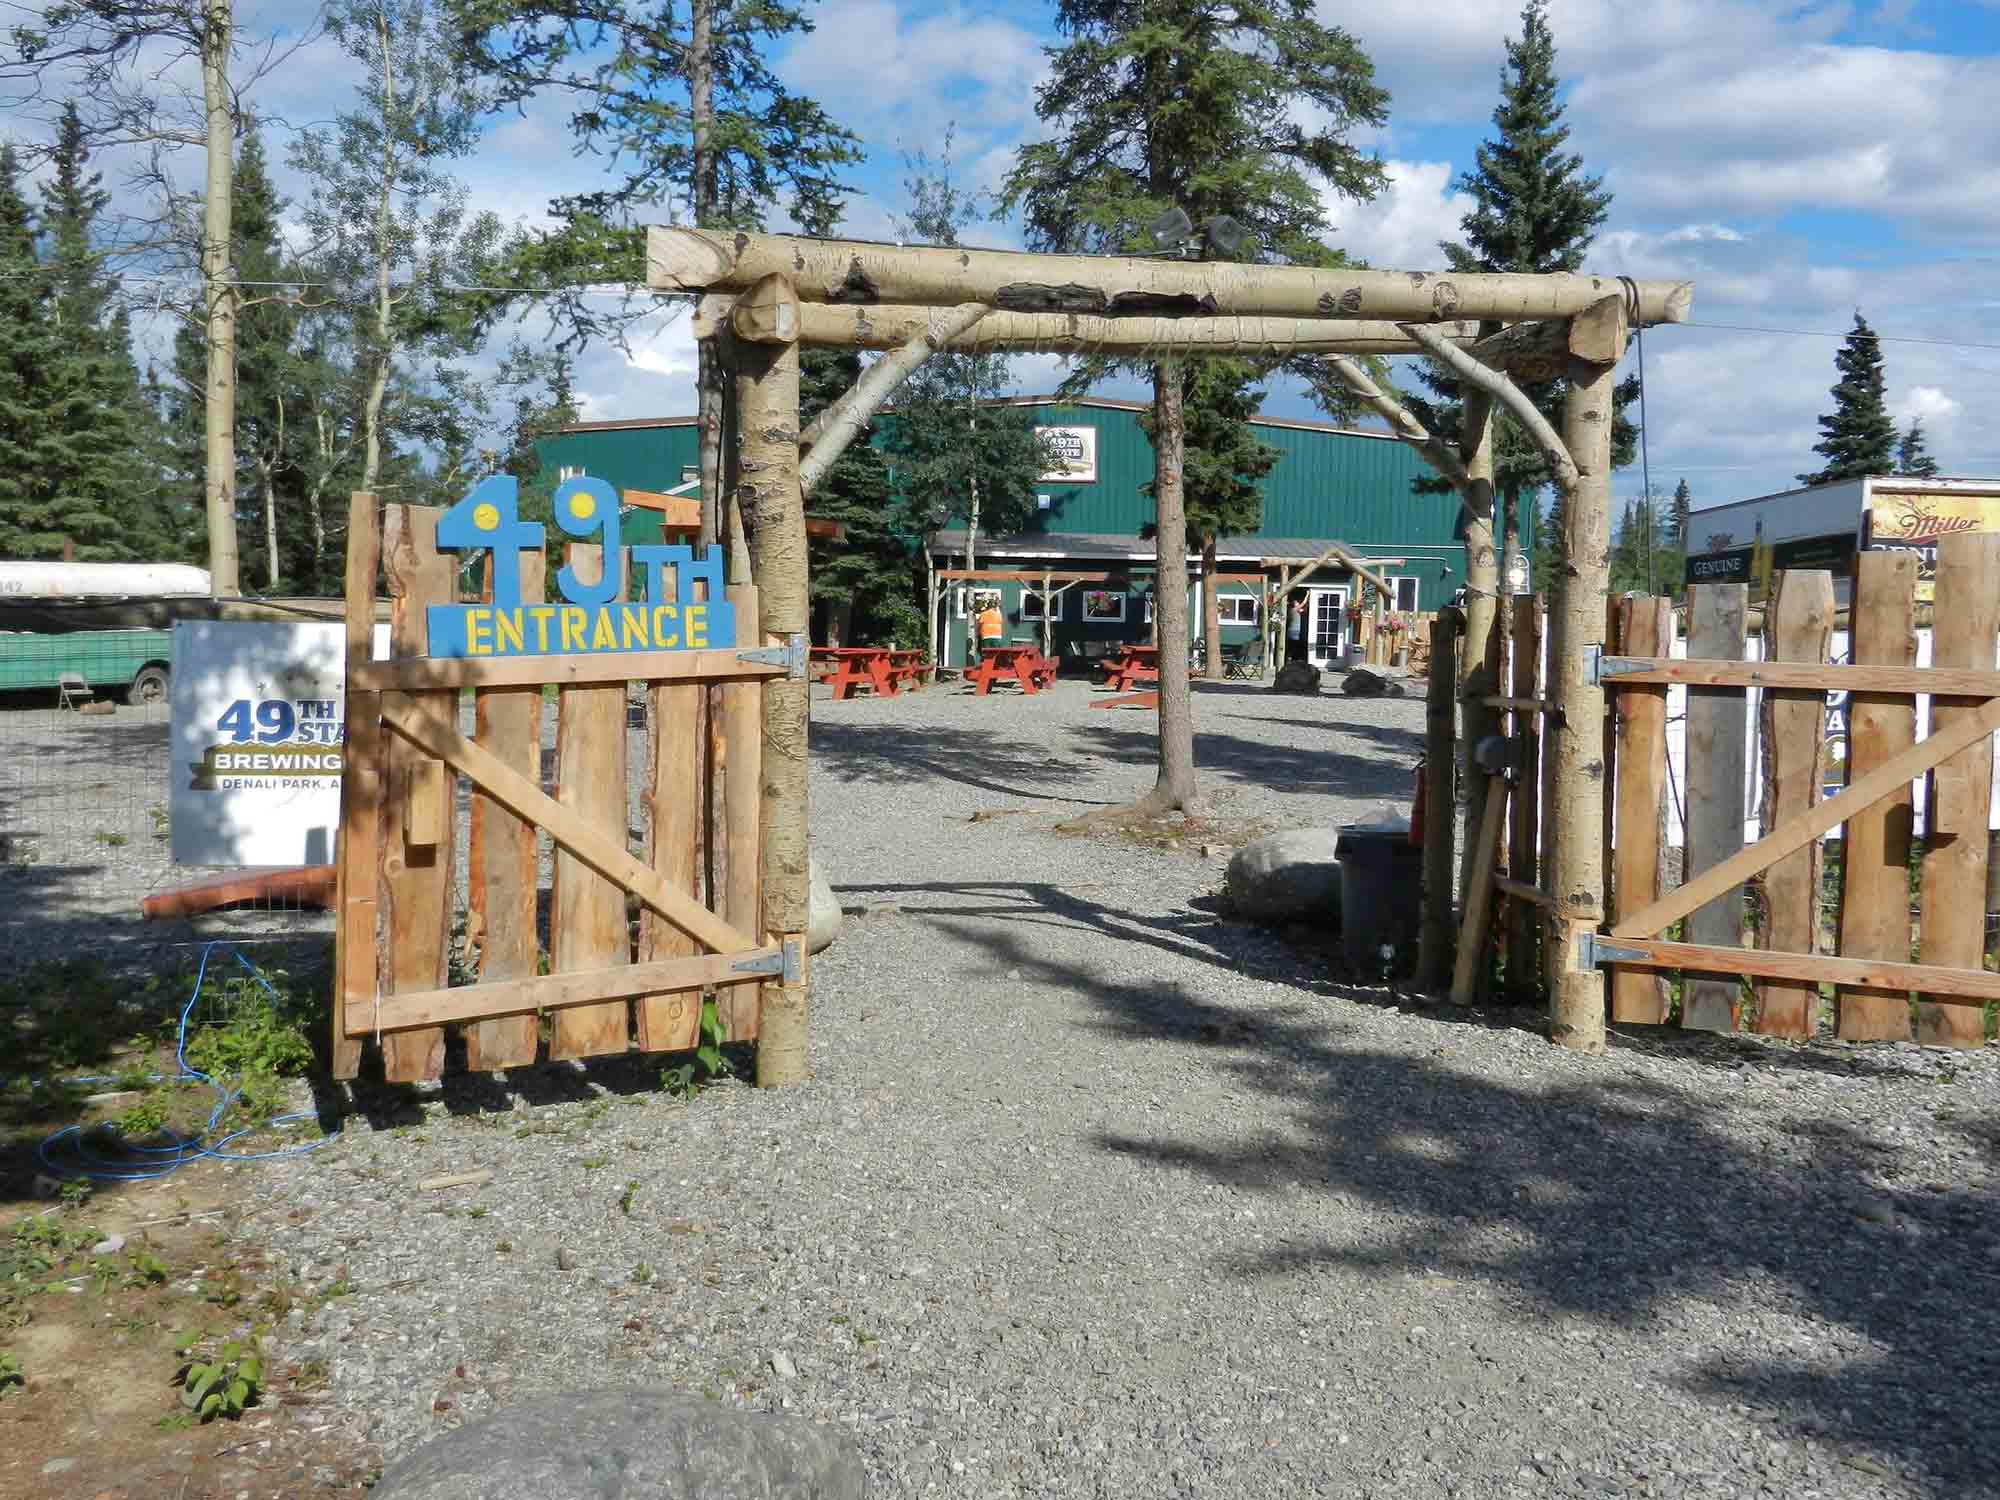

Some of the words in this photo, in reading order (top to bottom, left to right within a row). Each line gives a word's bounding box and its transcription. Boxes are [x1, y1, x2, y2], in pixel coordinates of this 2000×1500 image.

[1900, 514, 1981, 537] Miller
[436, 474, 725, 604] 49TH
[1694, 558, 1742, 576] GENUINE
[465, 605, 708, 656] ENTRANCE
[215, 754, 342, 769] BREWING
[223, 779, 277, 789] DENALI
